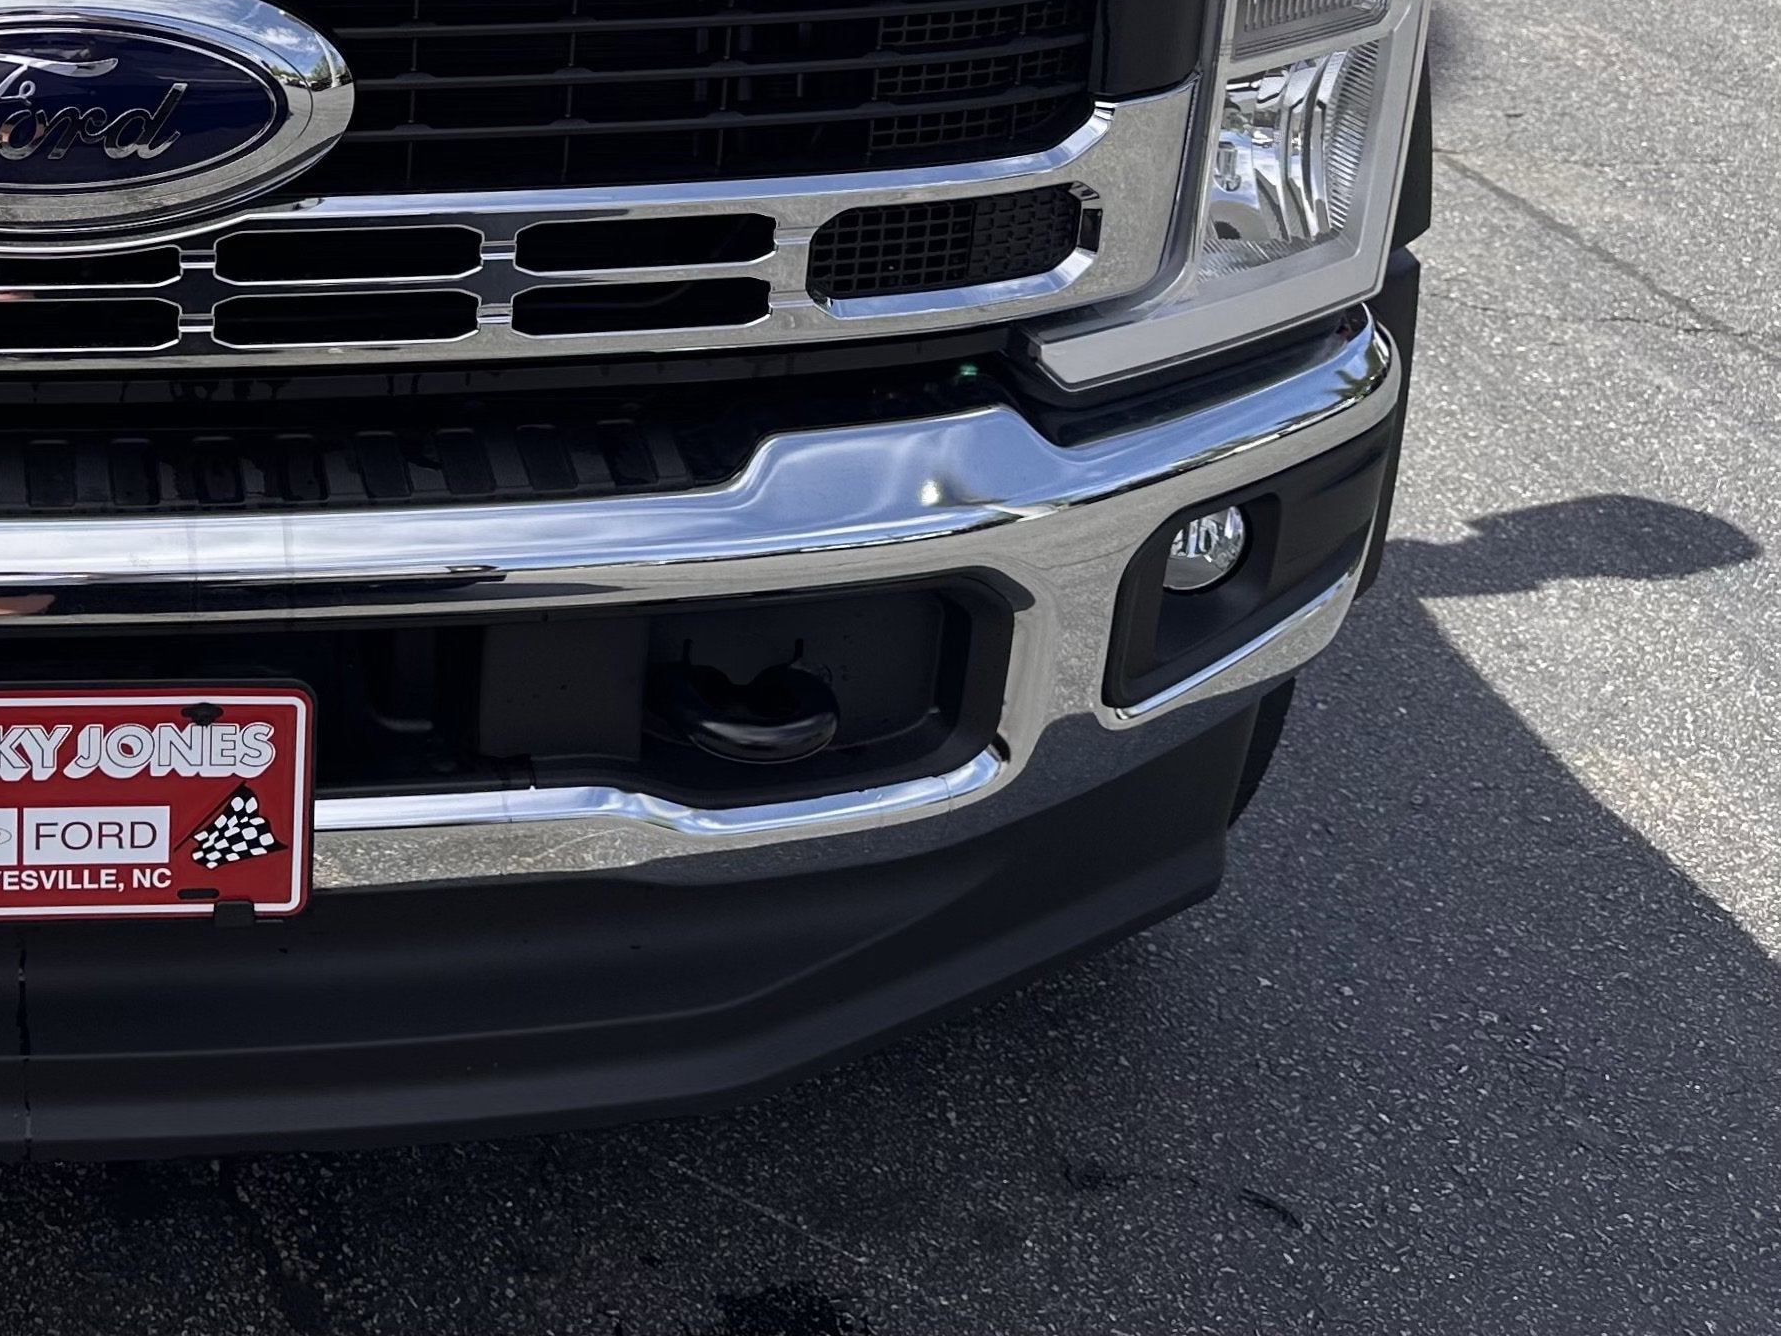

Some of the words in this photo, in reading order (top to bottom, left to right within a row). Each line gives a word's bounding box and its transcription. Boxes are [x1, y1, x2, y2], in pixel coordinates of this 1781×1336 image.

[62, 721, 277, 780] JONES
[34, 821, 158, 851] FORD
[132, 867, 173, 890] NC
